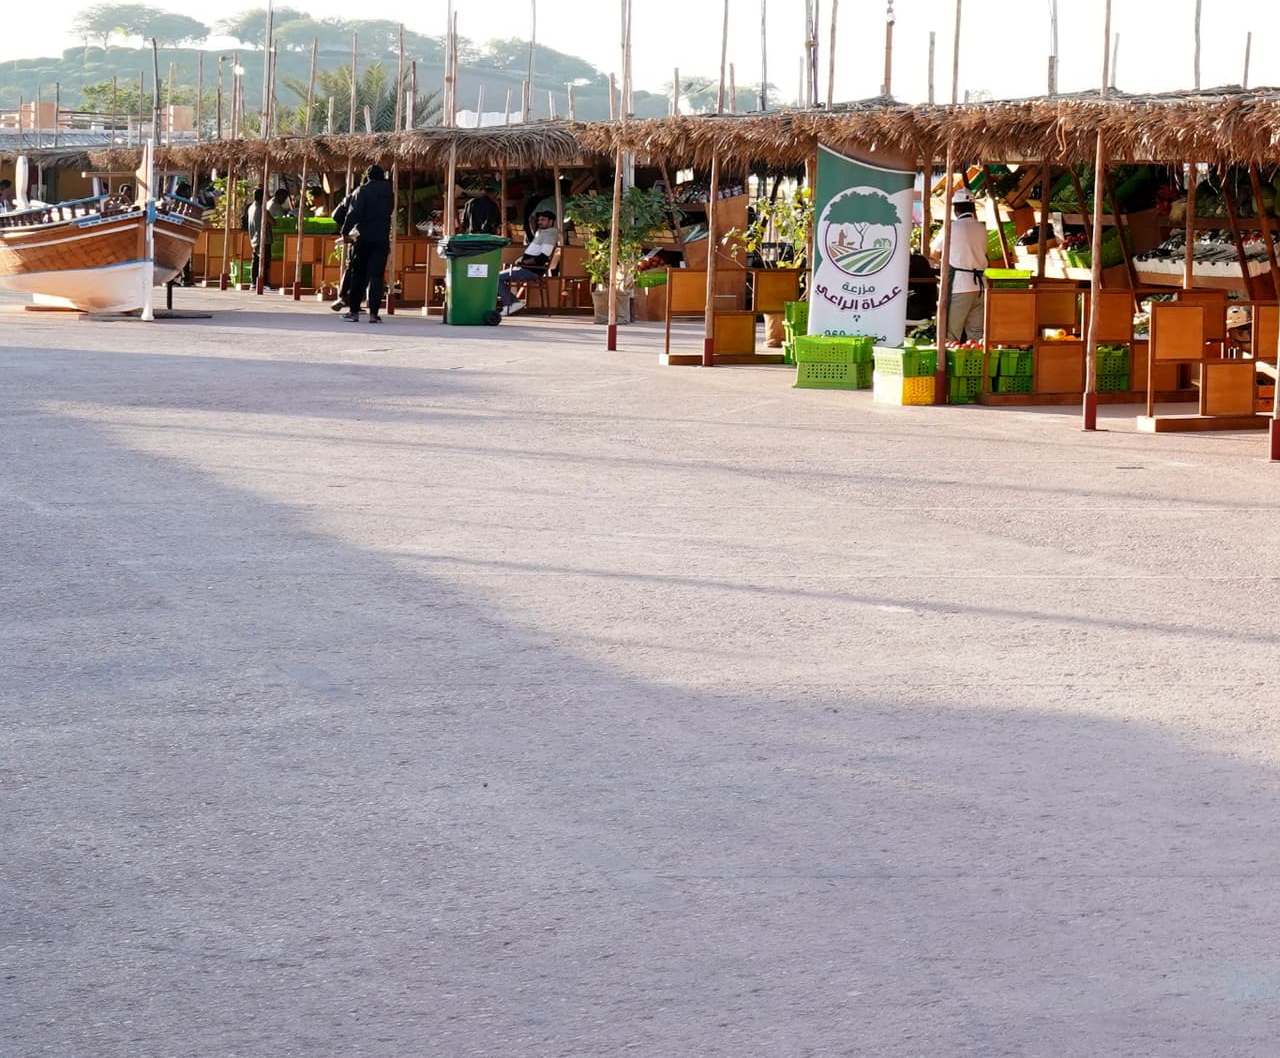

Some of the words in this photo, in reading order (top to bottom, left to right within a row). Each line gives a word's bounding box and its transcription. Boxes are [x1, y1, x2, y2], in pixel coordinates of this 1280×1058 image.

[815, 284, 858, 310] الراعي
[841, 282, 876, 295] مزرعة
[861, 285, 902, 310] عصاة
